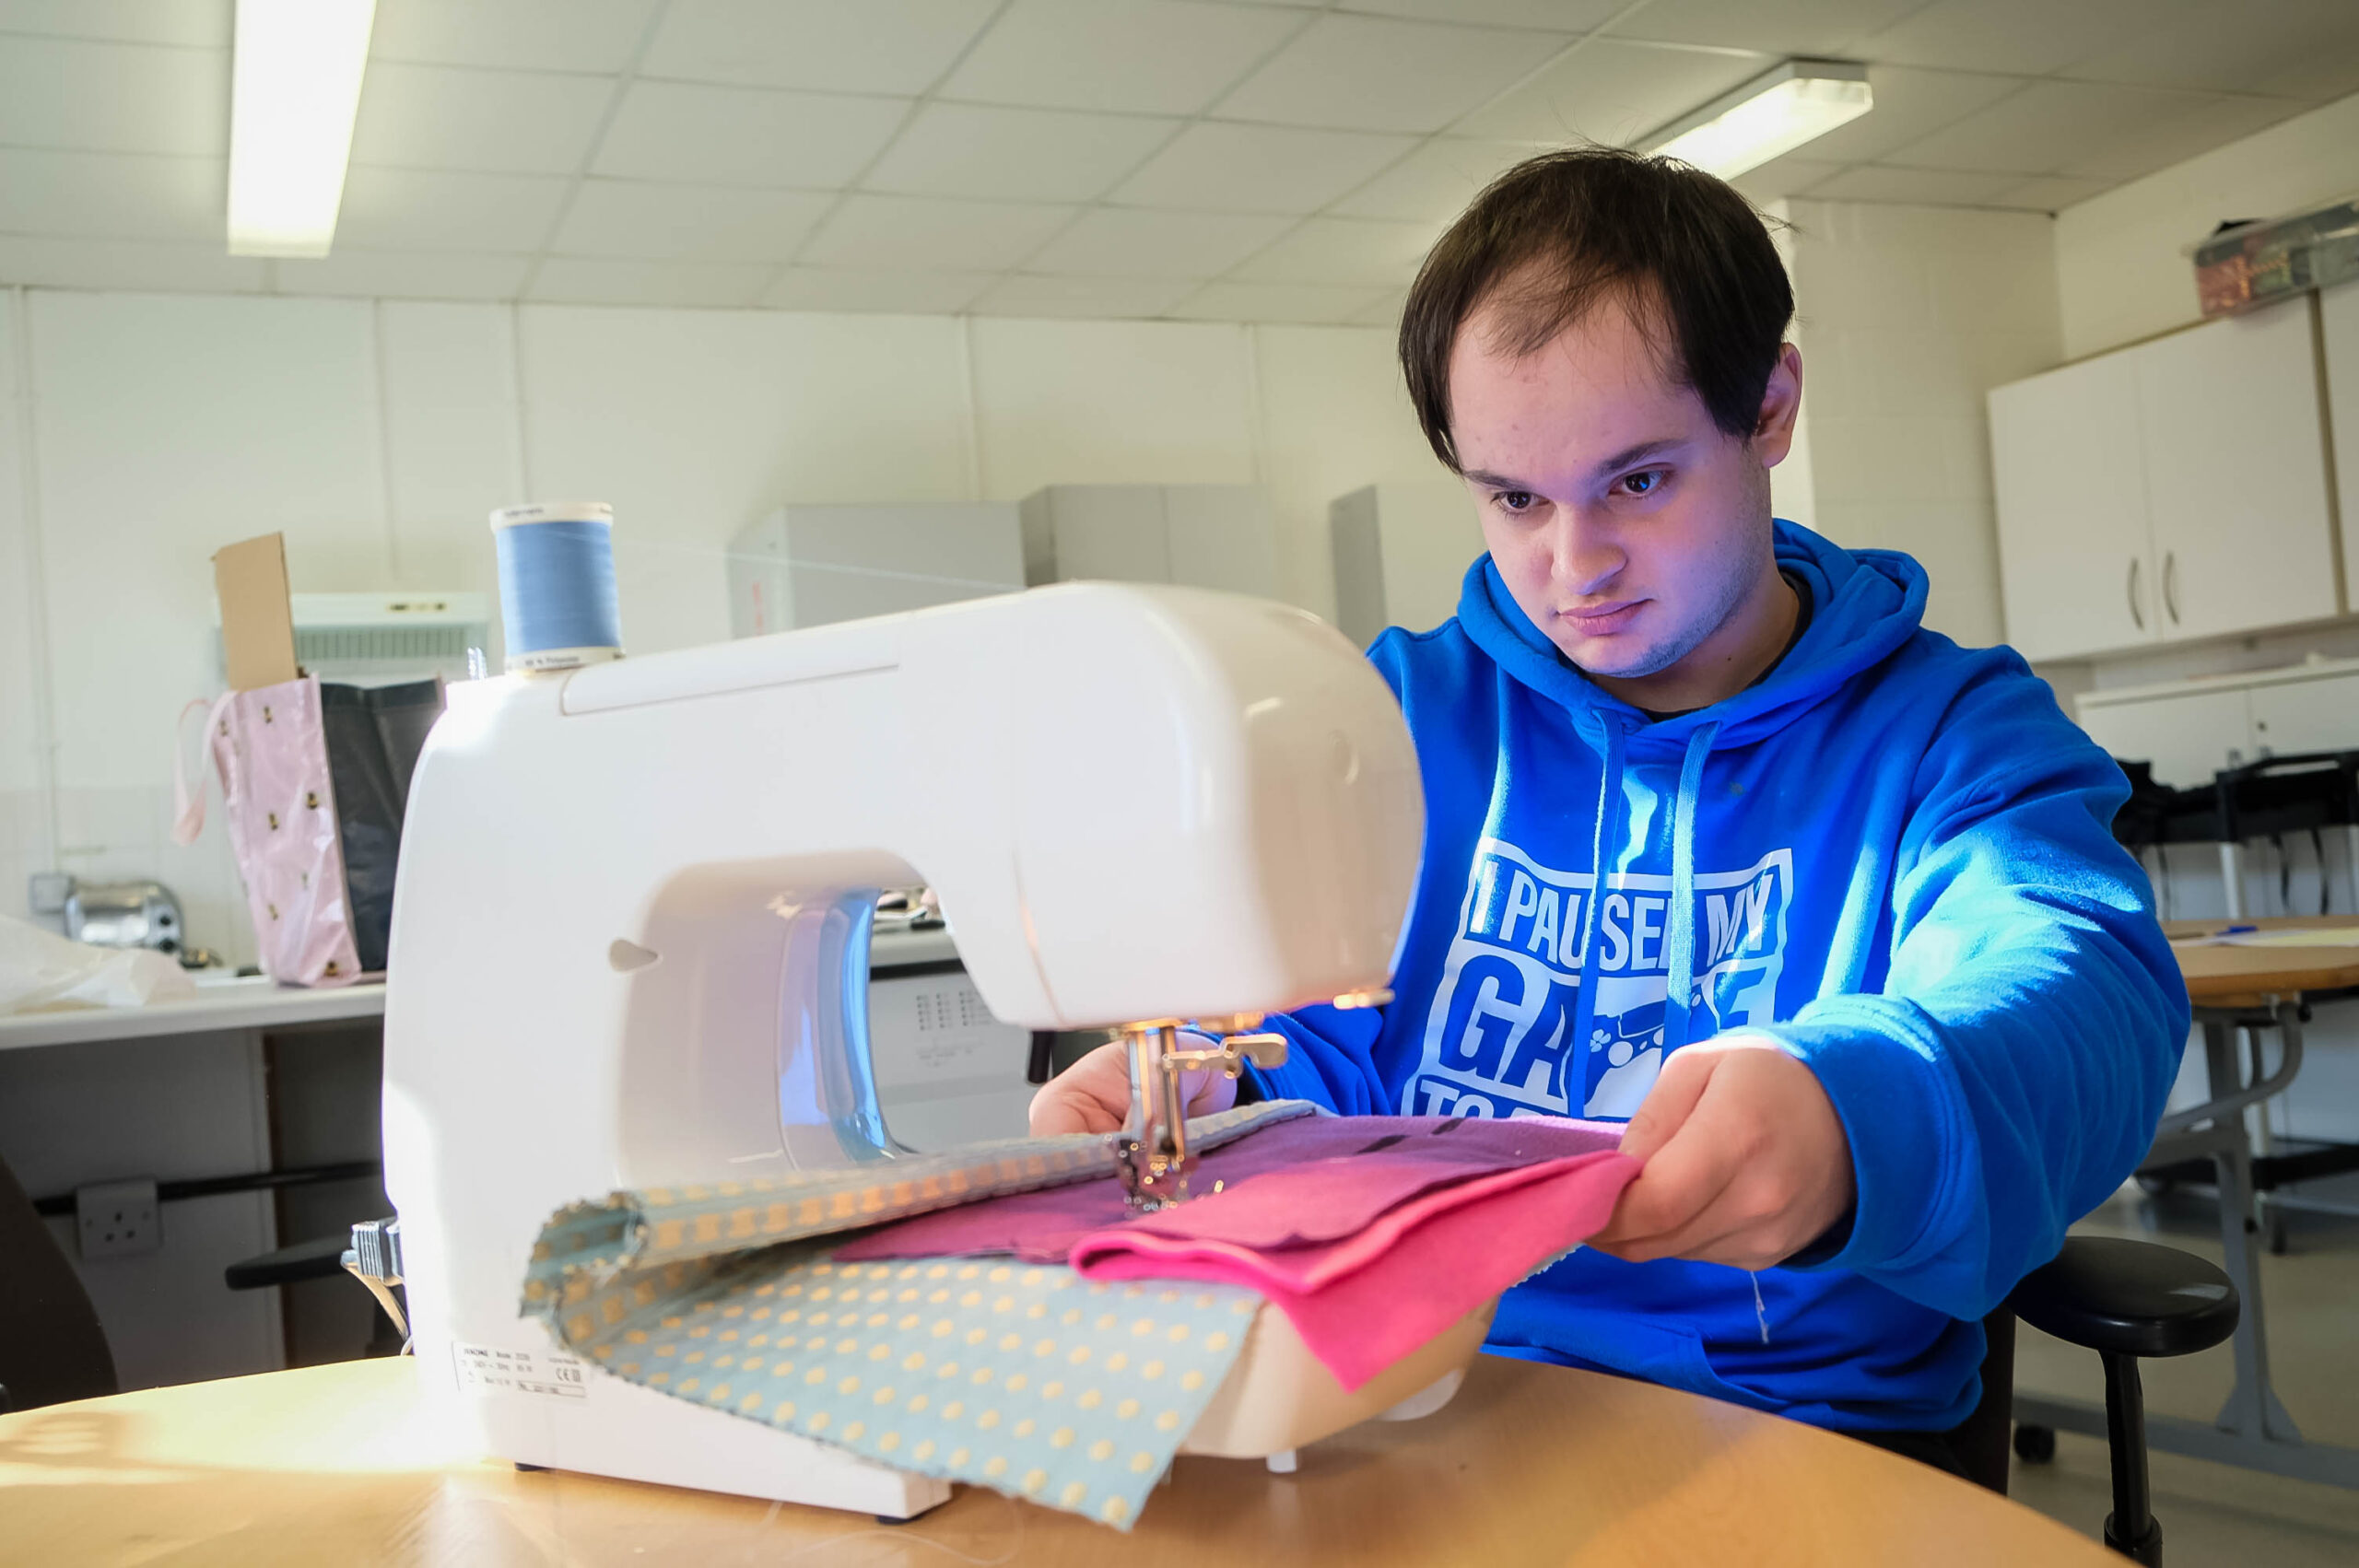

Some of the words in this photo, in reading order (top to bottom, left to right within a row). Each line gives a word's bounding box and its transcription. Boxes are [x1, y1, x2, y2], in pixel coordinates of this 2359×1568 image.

[1470, 860, 1497, 933] I
[1498, 869, 1683, 971] PAUSE
[1706, 873, 1774, 967] MY
